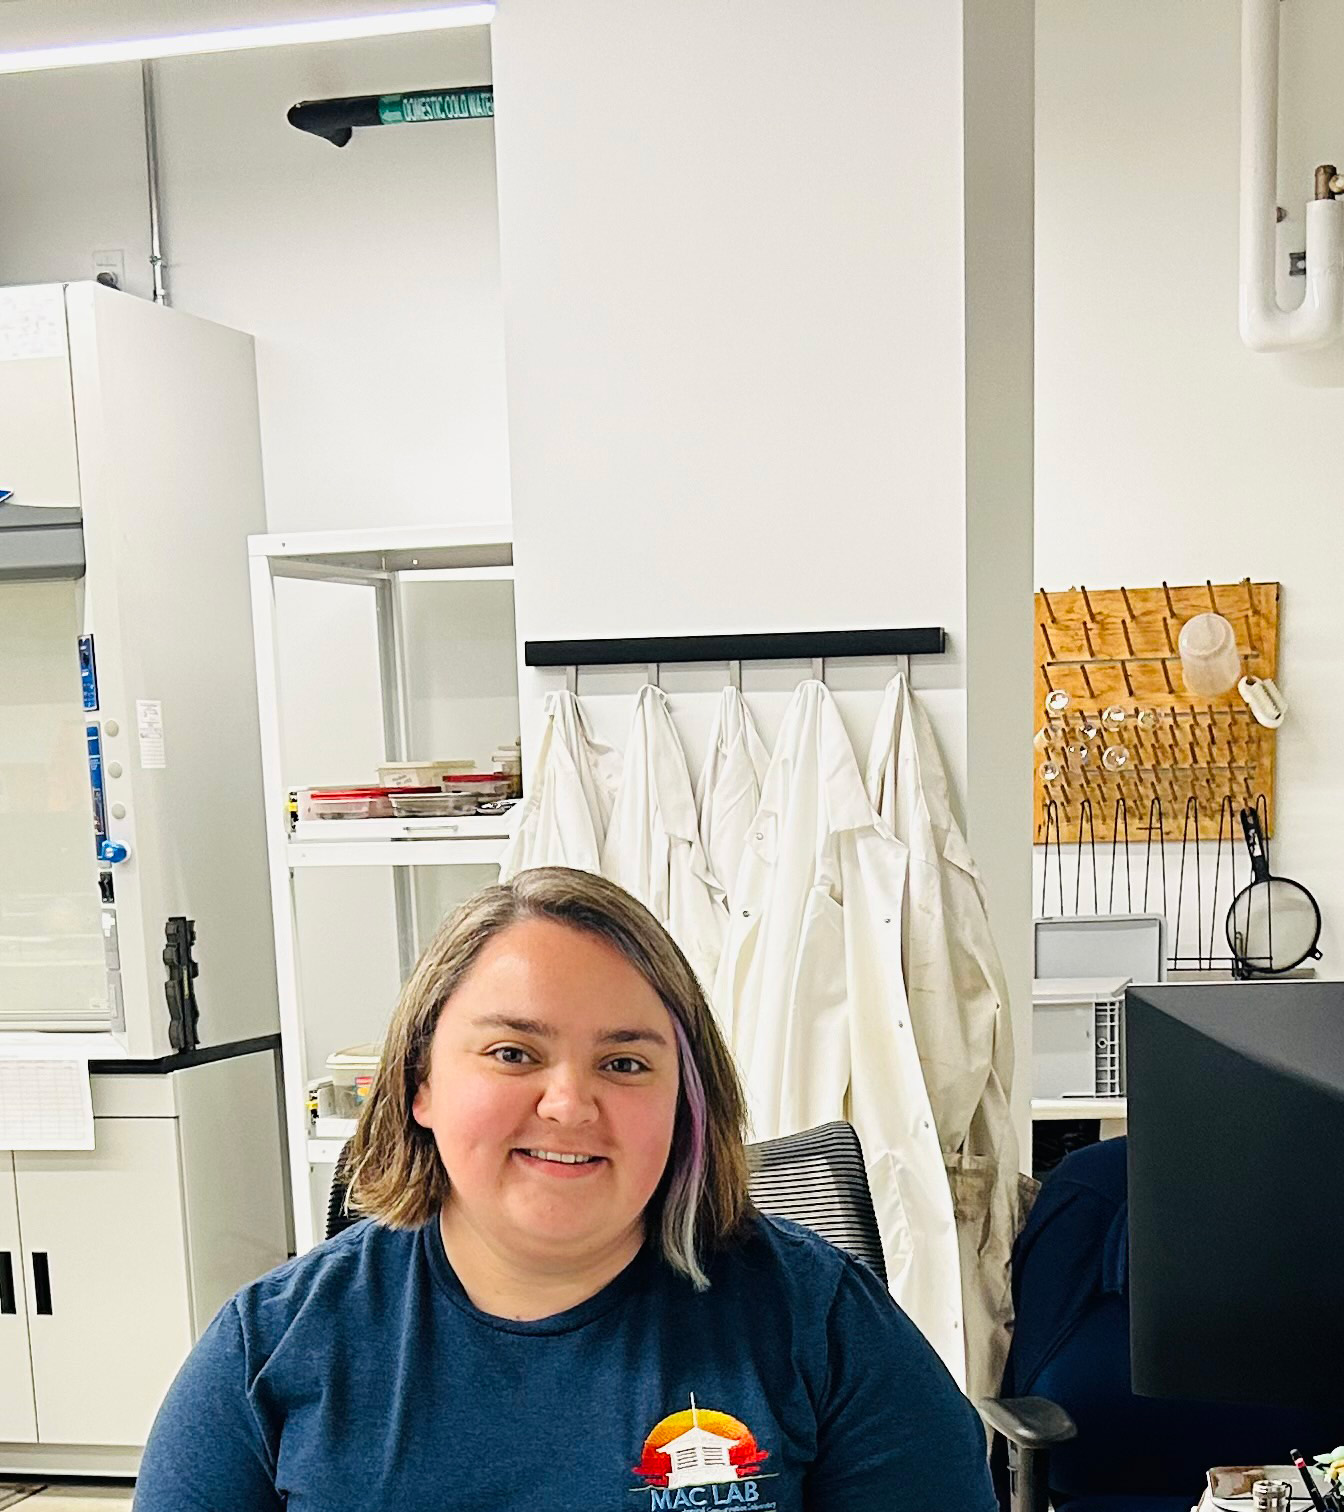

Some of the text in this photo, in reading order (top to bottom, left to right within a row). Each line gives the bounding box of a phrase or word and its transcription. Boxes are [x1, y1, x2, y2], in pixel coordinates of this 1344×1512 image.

[468, 91, 493, 117] WATE
[650, 1481, 760, 1512] MAC LAB
